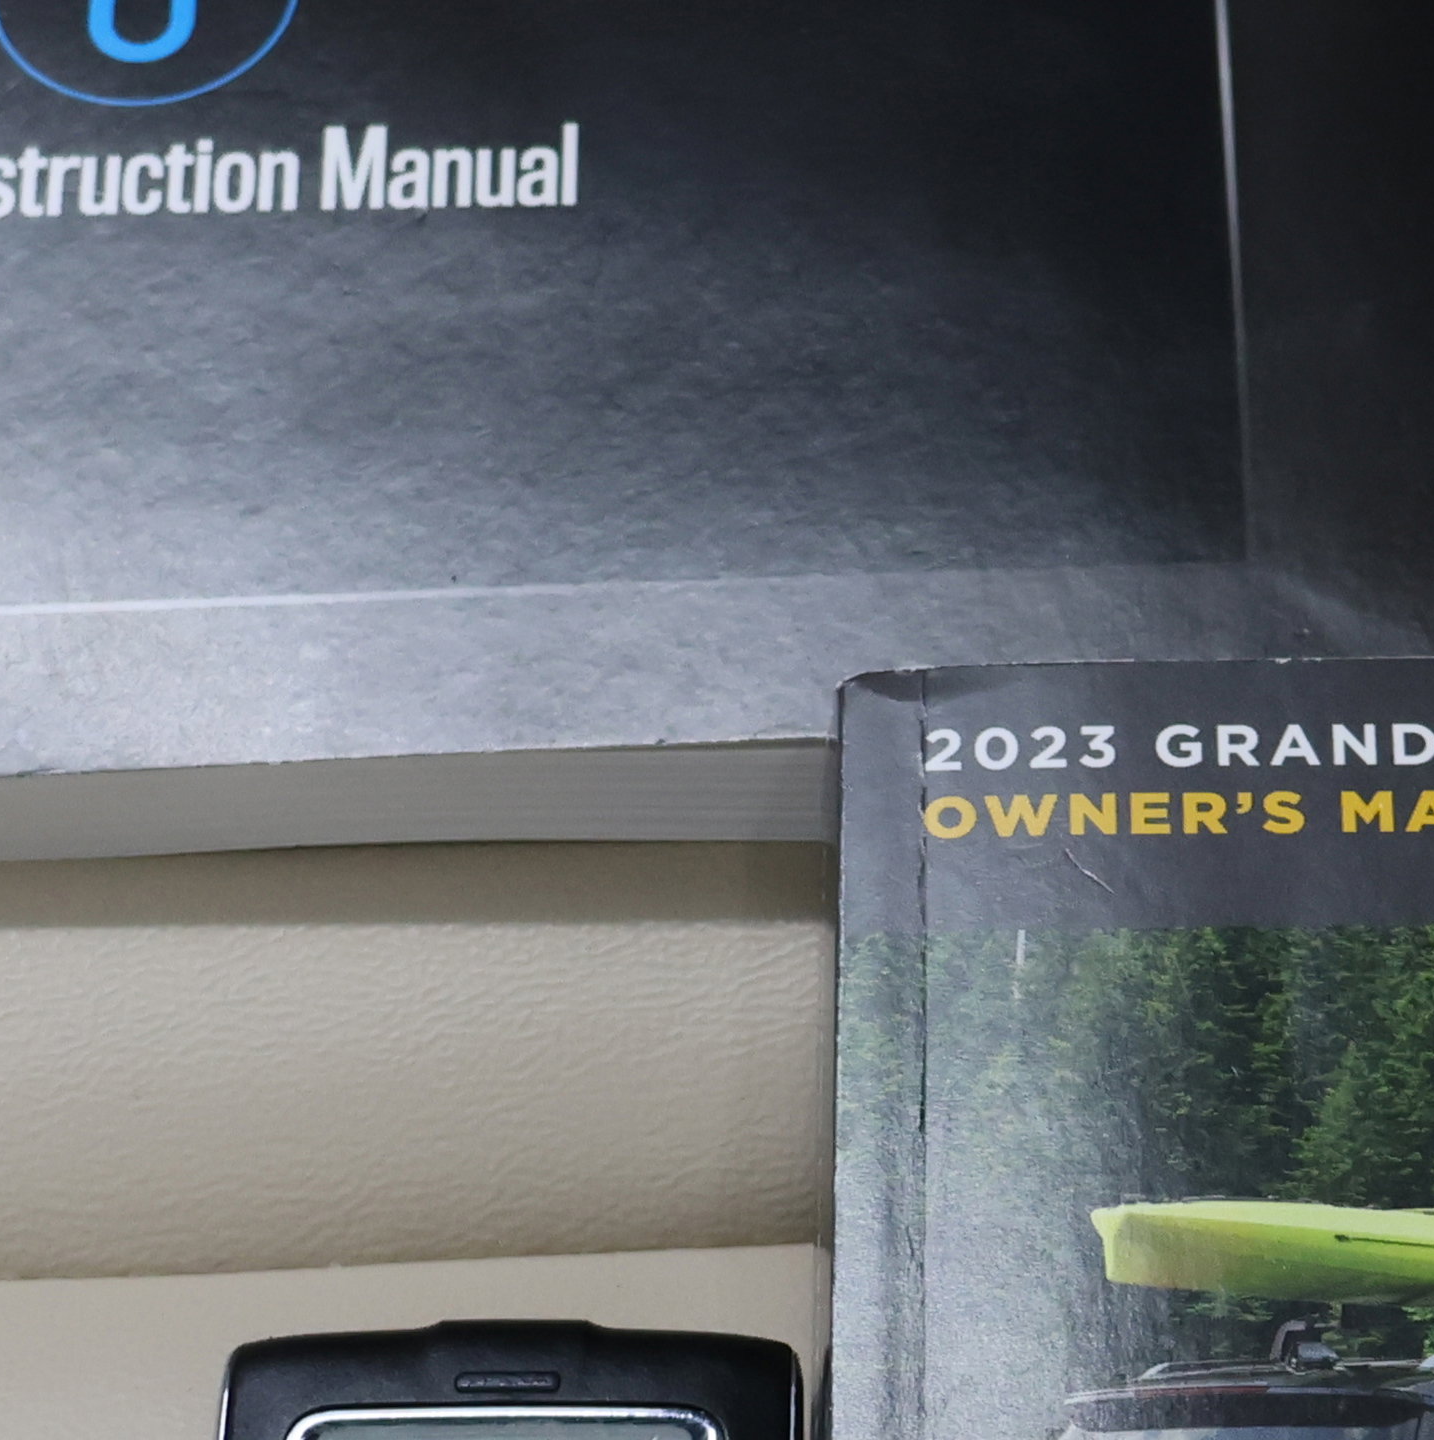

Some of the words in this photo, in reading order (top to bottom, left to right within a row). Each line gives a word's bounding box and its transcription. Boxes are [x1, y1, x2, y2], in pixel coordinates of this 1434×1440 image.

[321, 122, 580, 211] Manual
[925, 725, 1117, 773] 2023
[924, 789, 1305, 840] OWNER'S
